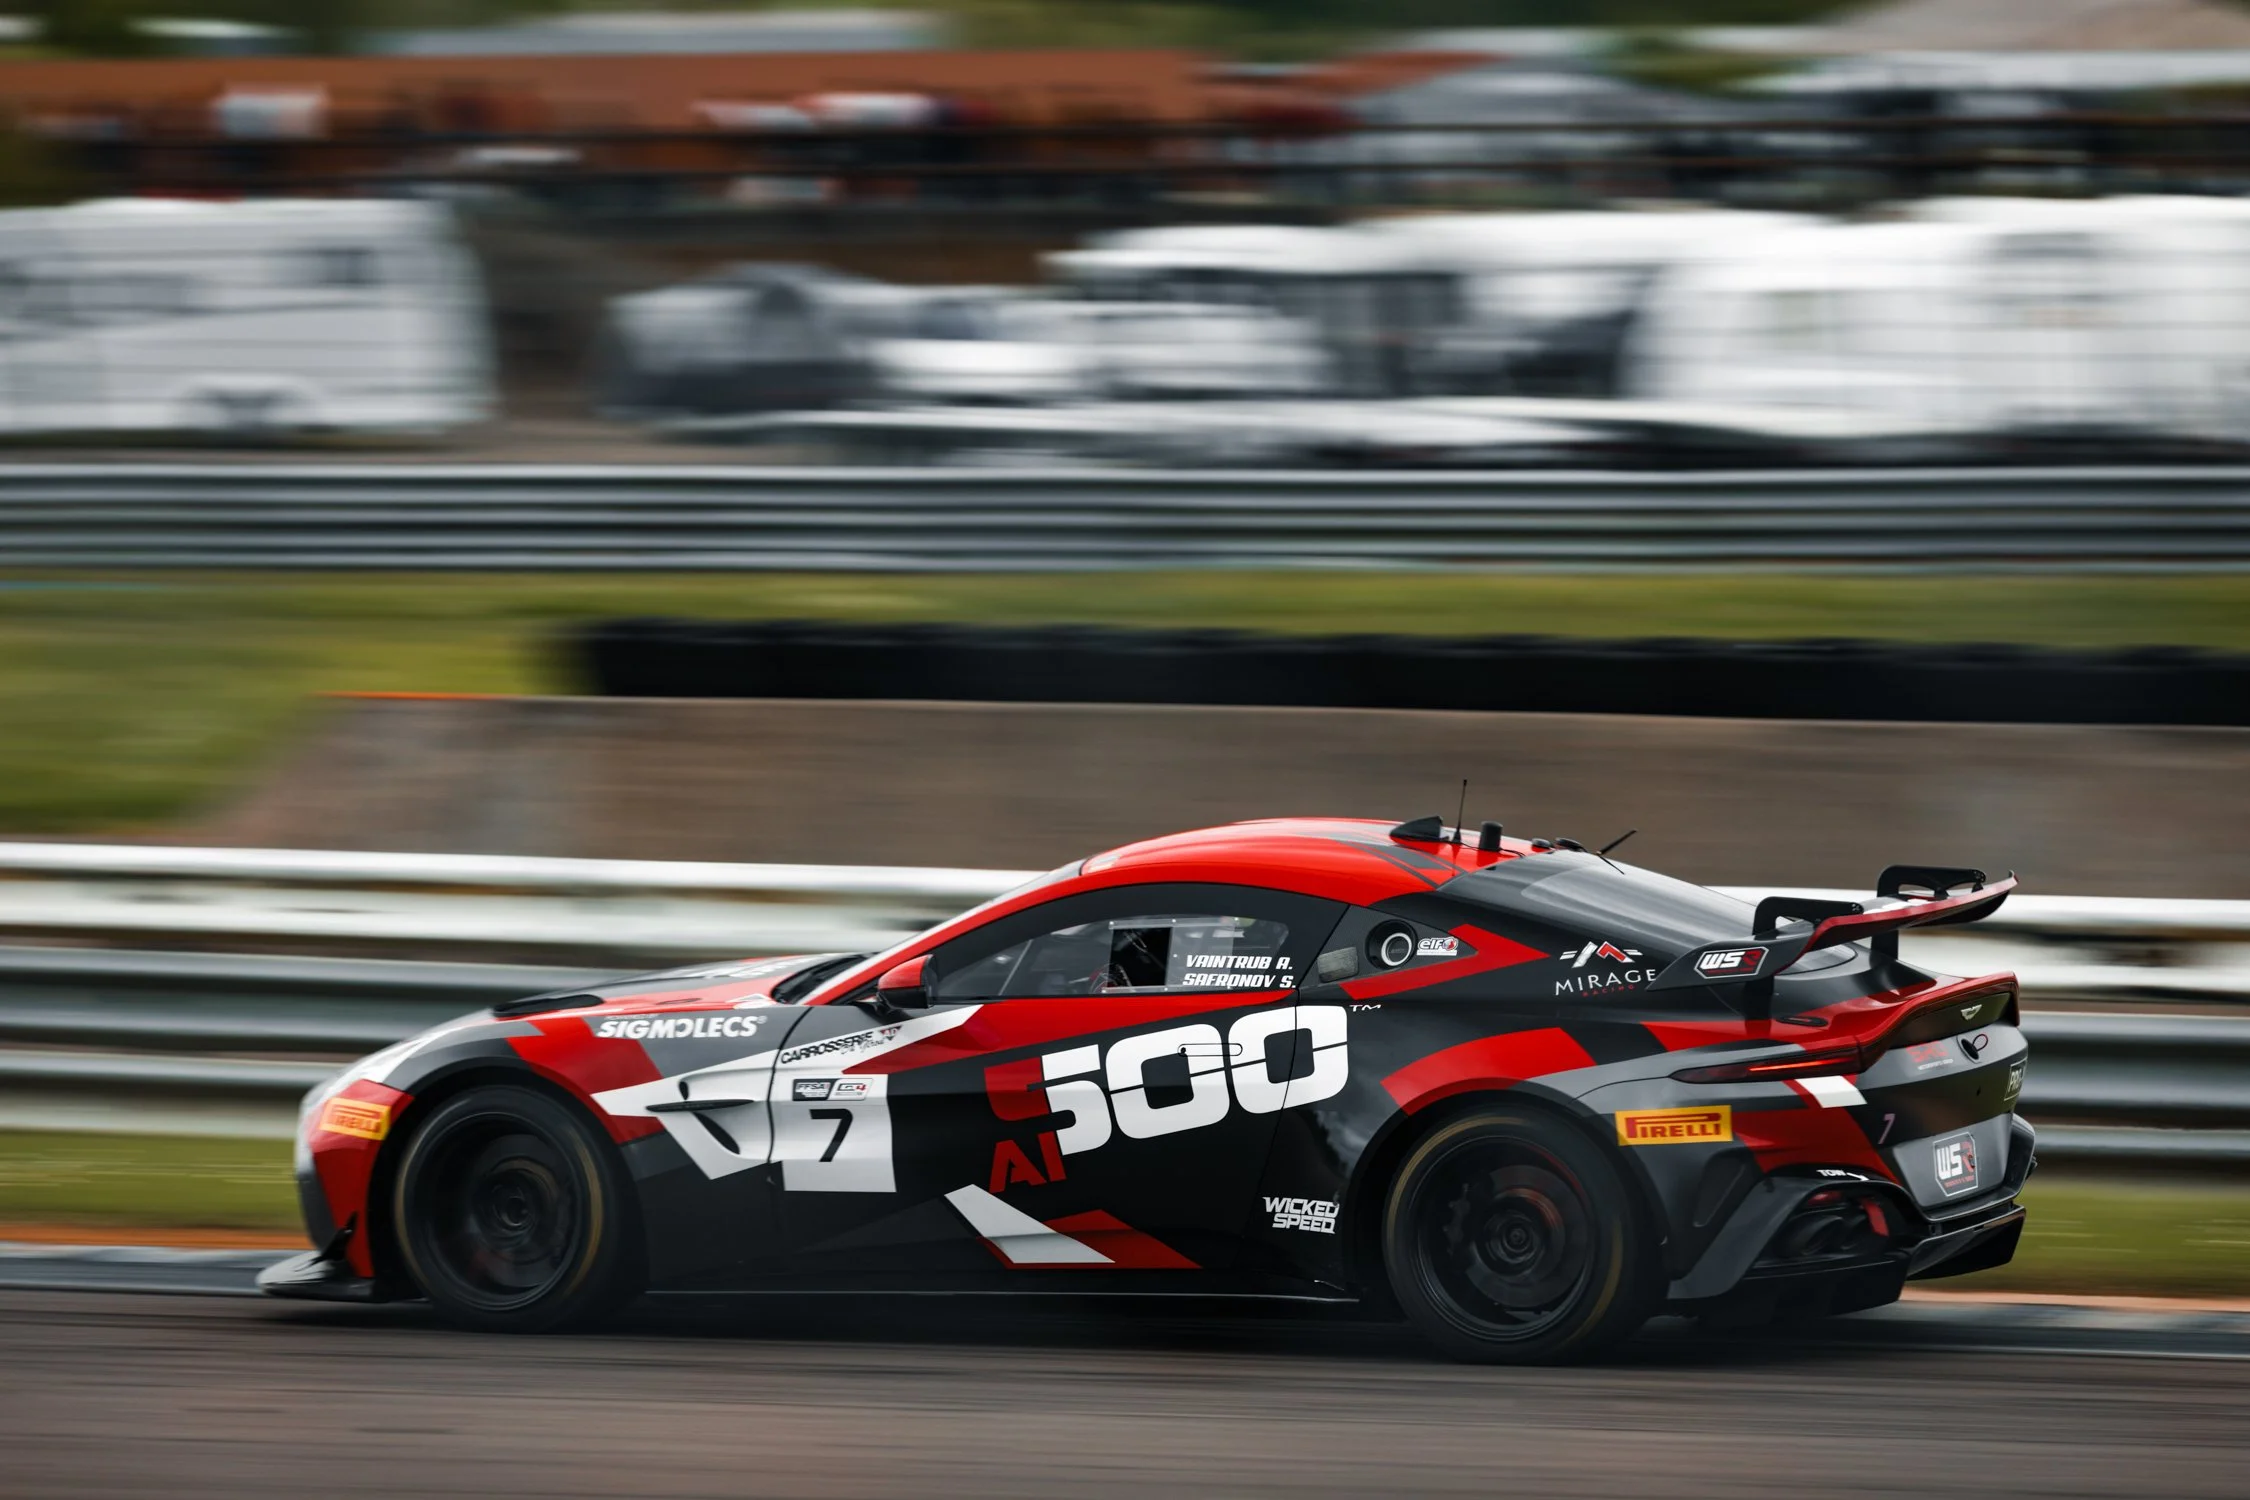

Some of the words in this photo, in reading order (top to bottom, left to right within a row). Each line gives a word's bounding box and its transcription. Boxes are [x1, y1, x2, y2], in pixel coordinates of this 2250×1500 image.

[1186, 955, 1272, 969] VAINTRUB
[1276, 957, 1293, 970] A.
[1183, 973, 1276, 989] SAFRONOV
[1280, 975, 1297, 989] S.
[1555, 968, 1656, 996] MIRAGE
[781, 1031, 874, 1064] CARROSSERIE
[809, 1108, 854, 1163] 7
[1624, 1113, 1722, 1139] PIRELLI
[1877, 1113, 1896, 1145] 7
[988, 1131, 1066, 1193] AI
[1816, 1168, 1847, 1177] TOW
[1262, 1196, 1340, 1218] WICKED
[1272, 1213, 1336, 1234] SPEED
